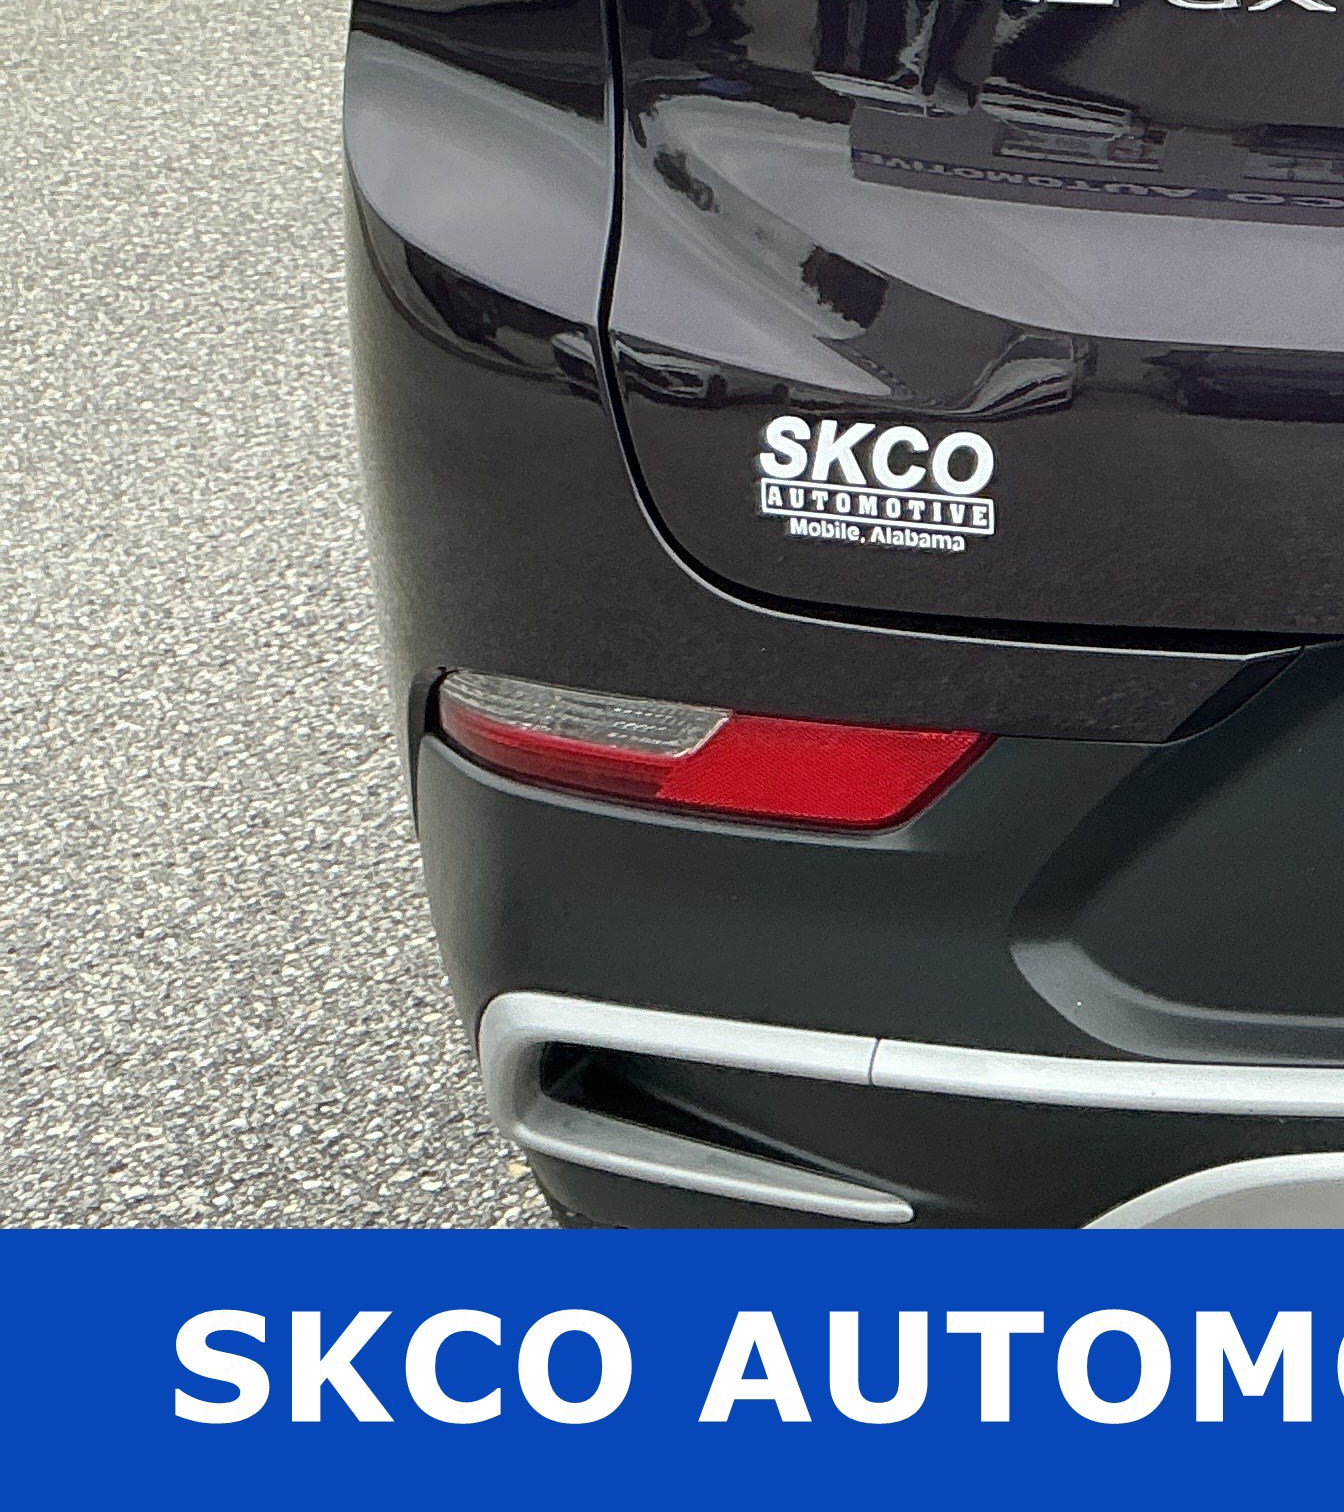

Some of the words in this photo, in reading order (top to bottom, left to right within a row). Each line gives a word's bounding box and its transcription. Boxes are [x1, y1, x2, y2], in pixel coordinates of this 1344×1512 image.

[760, 415, 995, 495] SKCO
[767, 486, 988, 527] AUTOMOTIVE
[789, 517, 866, 544] Mobile,
[869, 525, 965, 552] Alabama
